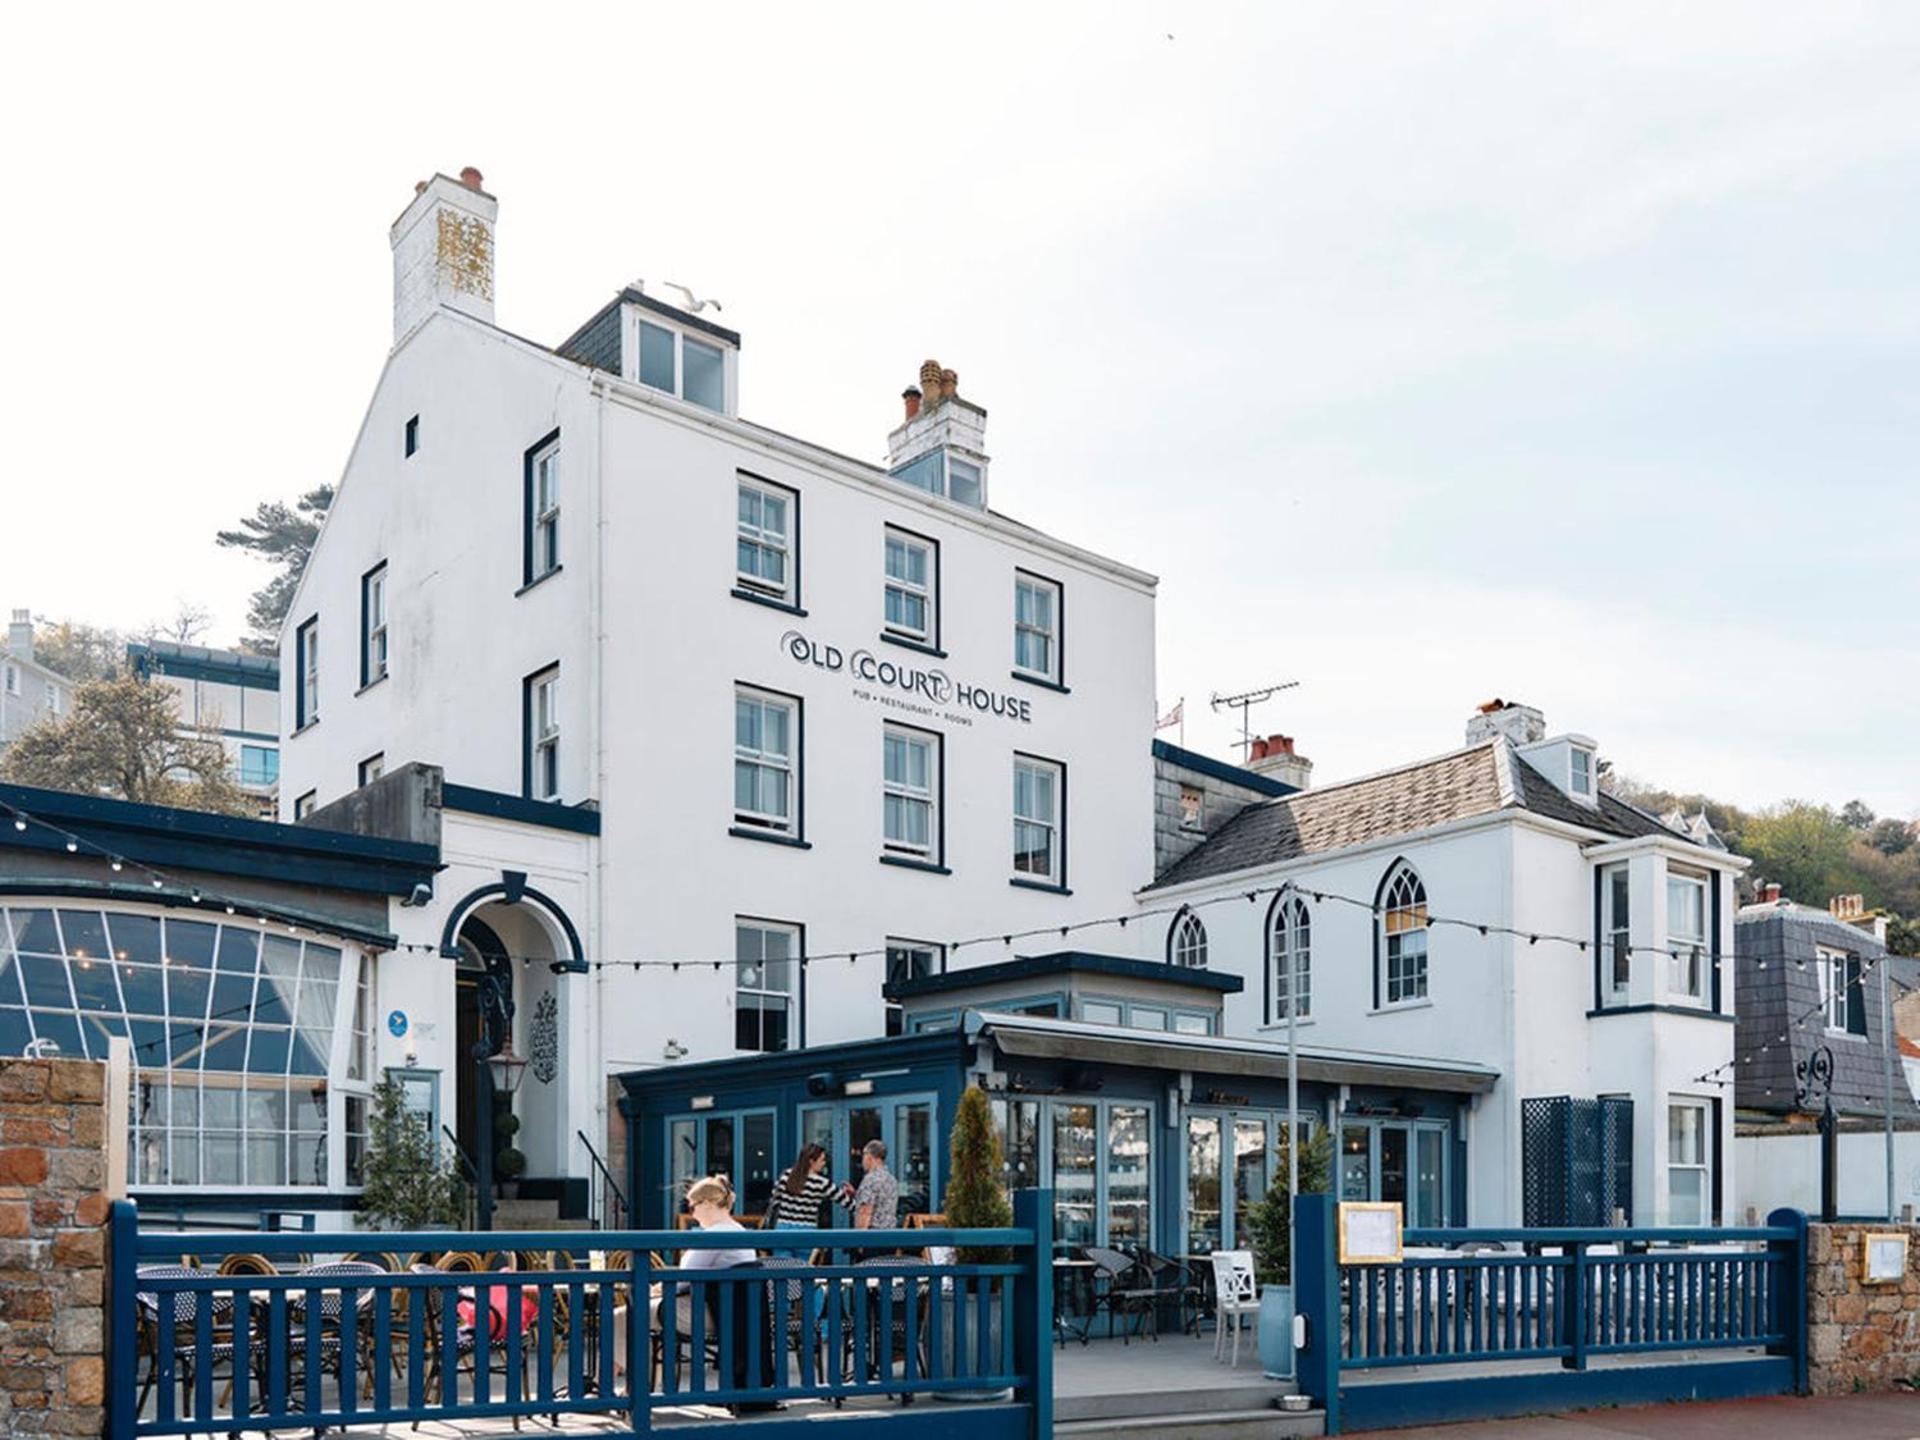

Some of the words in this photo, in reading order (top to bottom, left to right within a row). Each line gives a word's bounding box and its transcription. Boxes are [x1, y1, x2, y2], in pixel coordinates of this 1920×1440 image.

[782, 631, 842, 670] OLD
[851, 651, 950, 704] COURT
[957, 683, 1031, 722] HOUSE
[853, 689, 870, 700] PUB
[880, 697, 933, 715] RESTAURANT
[944, 712, 973, 726] ROOMS
